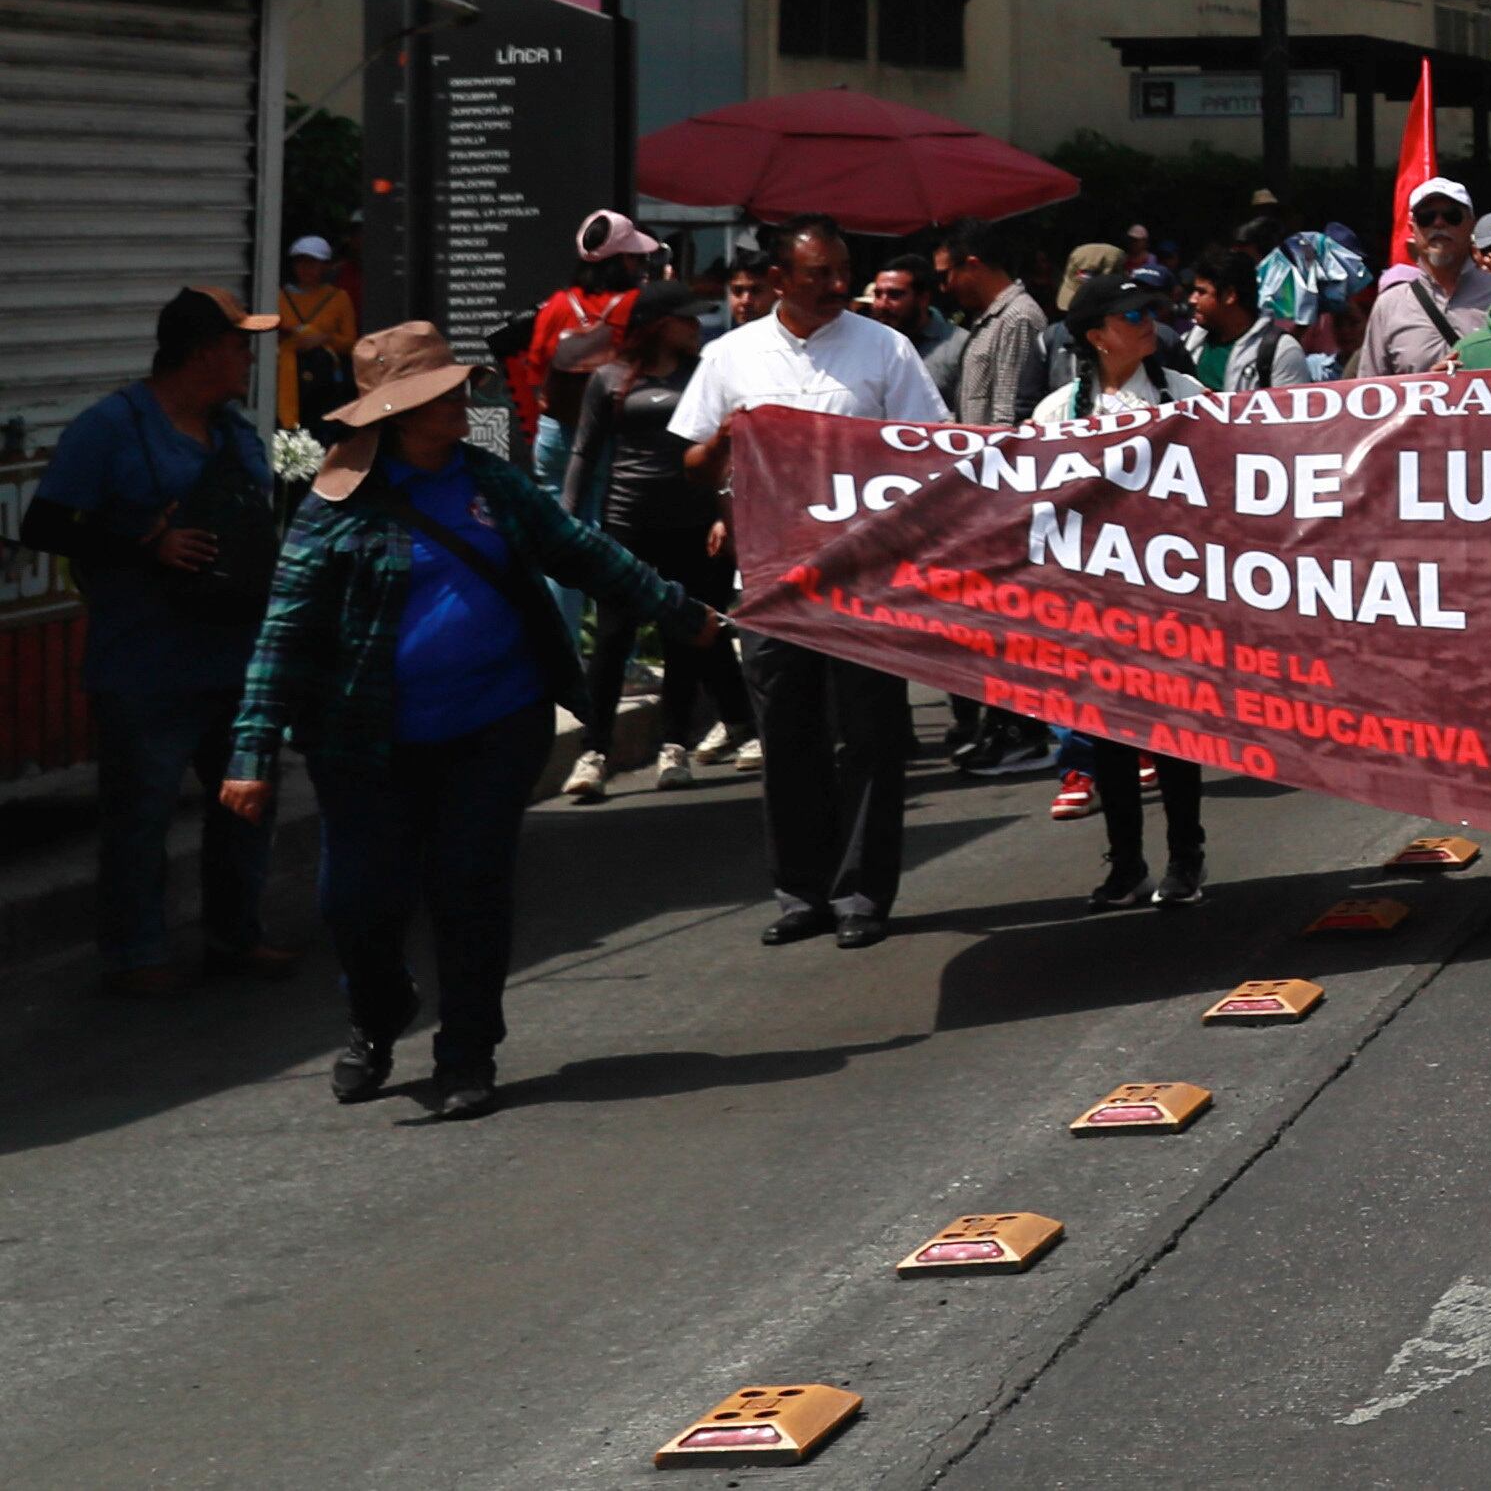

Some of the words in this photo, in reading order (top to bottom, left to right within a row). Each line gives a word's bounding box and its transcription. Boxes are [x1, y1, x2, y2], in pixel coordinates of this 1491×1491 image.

[807, 435, 1210, 524] JONADA
[1234, 449, 1346, 520] DE
[890, 559, 1226, 668] ABROGACIÓN
[1234, 644, 1282, 676] DE
[1286, 654, 1334, 689] LA
[1027, 499, 1468, 631] NACIONAL
[831, 588, 997, 657] LLAMADA
[1003, 631, 1226, 718] REFORMA
[1234, 688, 1491, 770] EDUCATIVA
[983, 675, 1108, 737] PEÑA
[1147, 721, 1278, 779] AMLO
